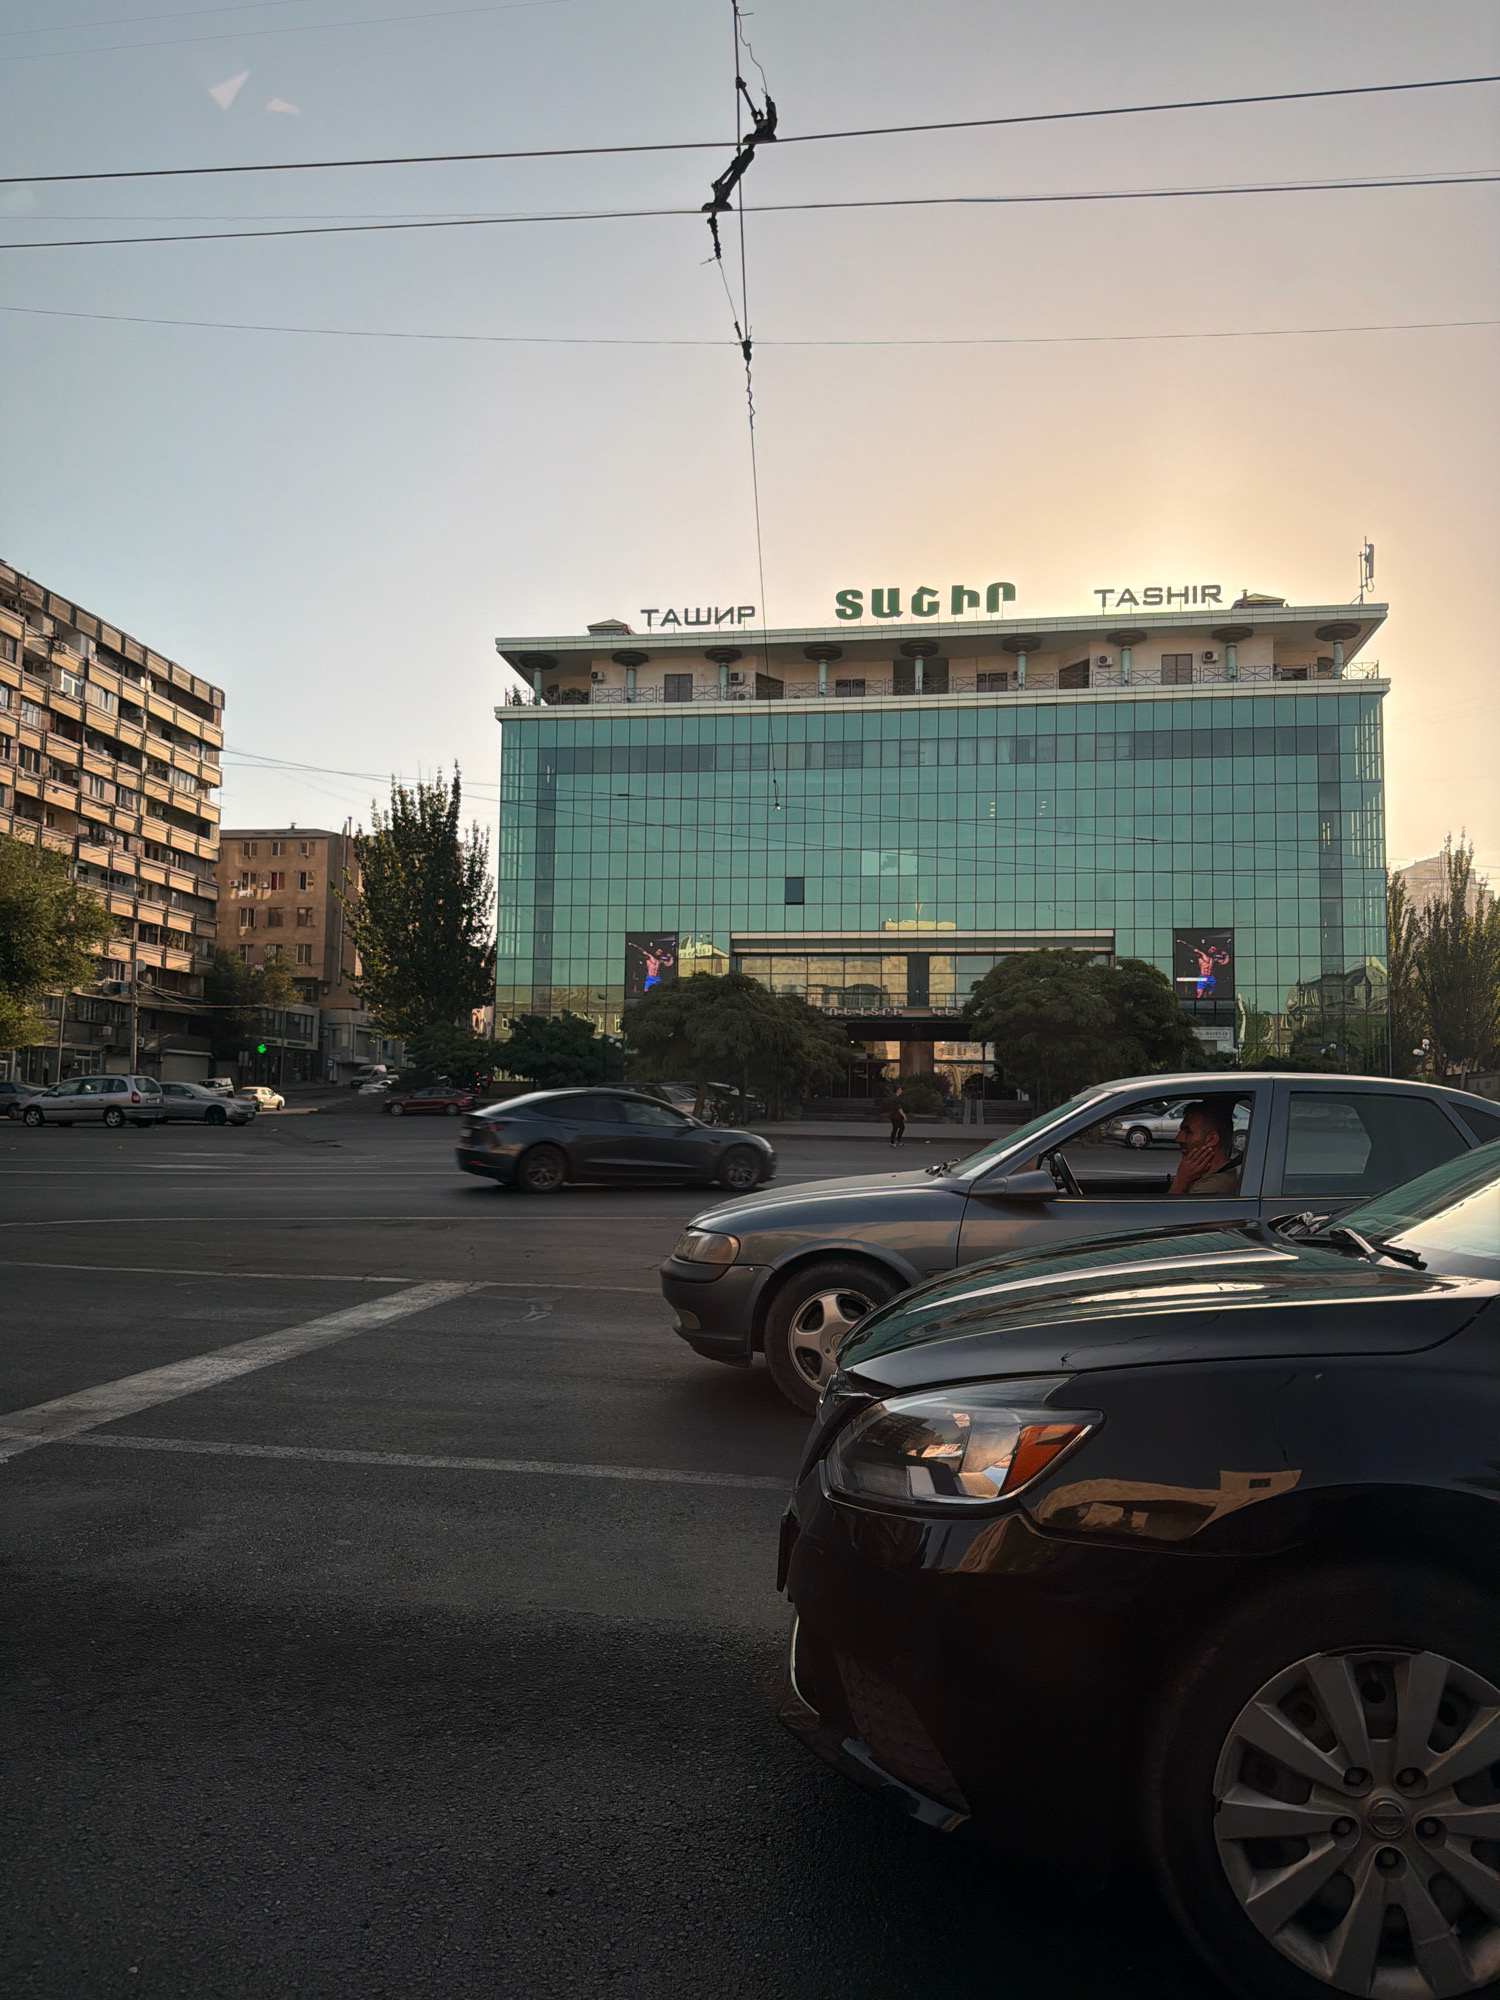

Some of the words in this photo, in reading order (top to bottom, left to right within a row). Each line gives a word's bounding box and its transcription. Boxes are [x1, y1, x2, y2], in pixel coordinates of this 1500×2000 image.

[835, 582, 1016, 620] ՏԱՇԻՐ
[1093, 584, 1224, 608] TASHIR
[640, 606, 755, 627] ТАШИР
